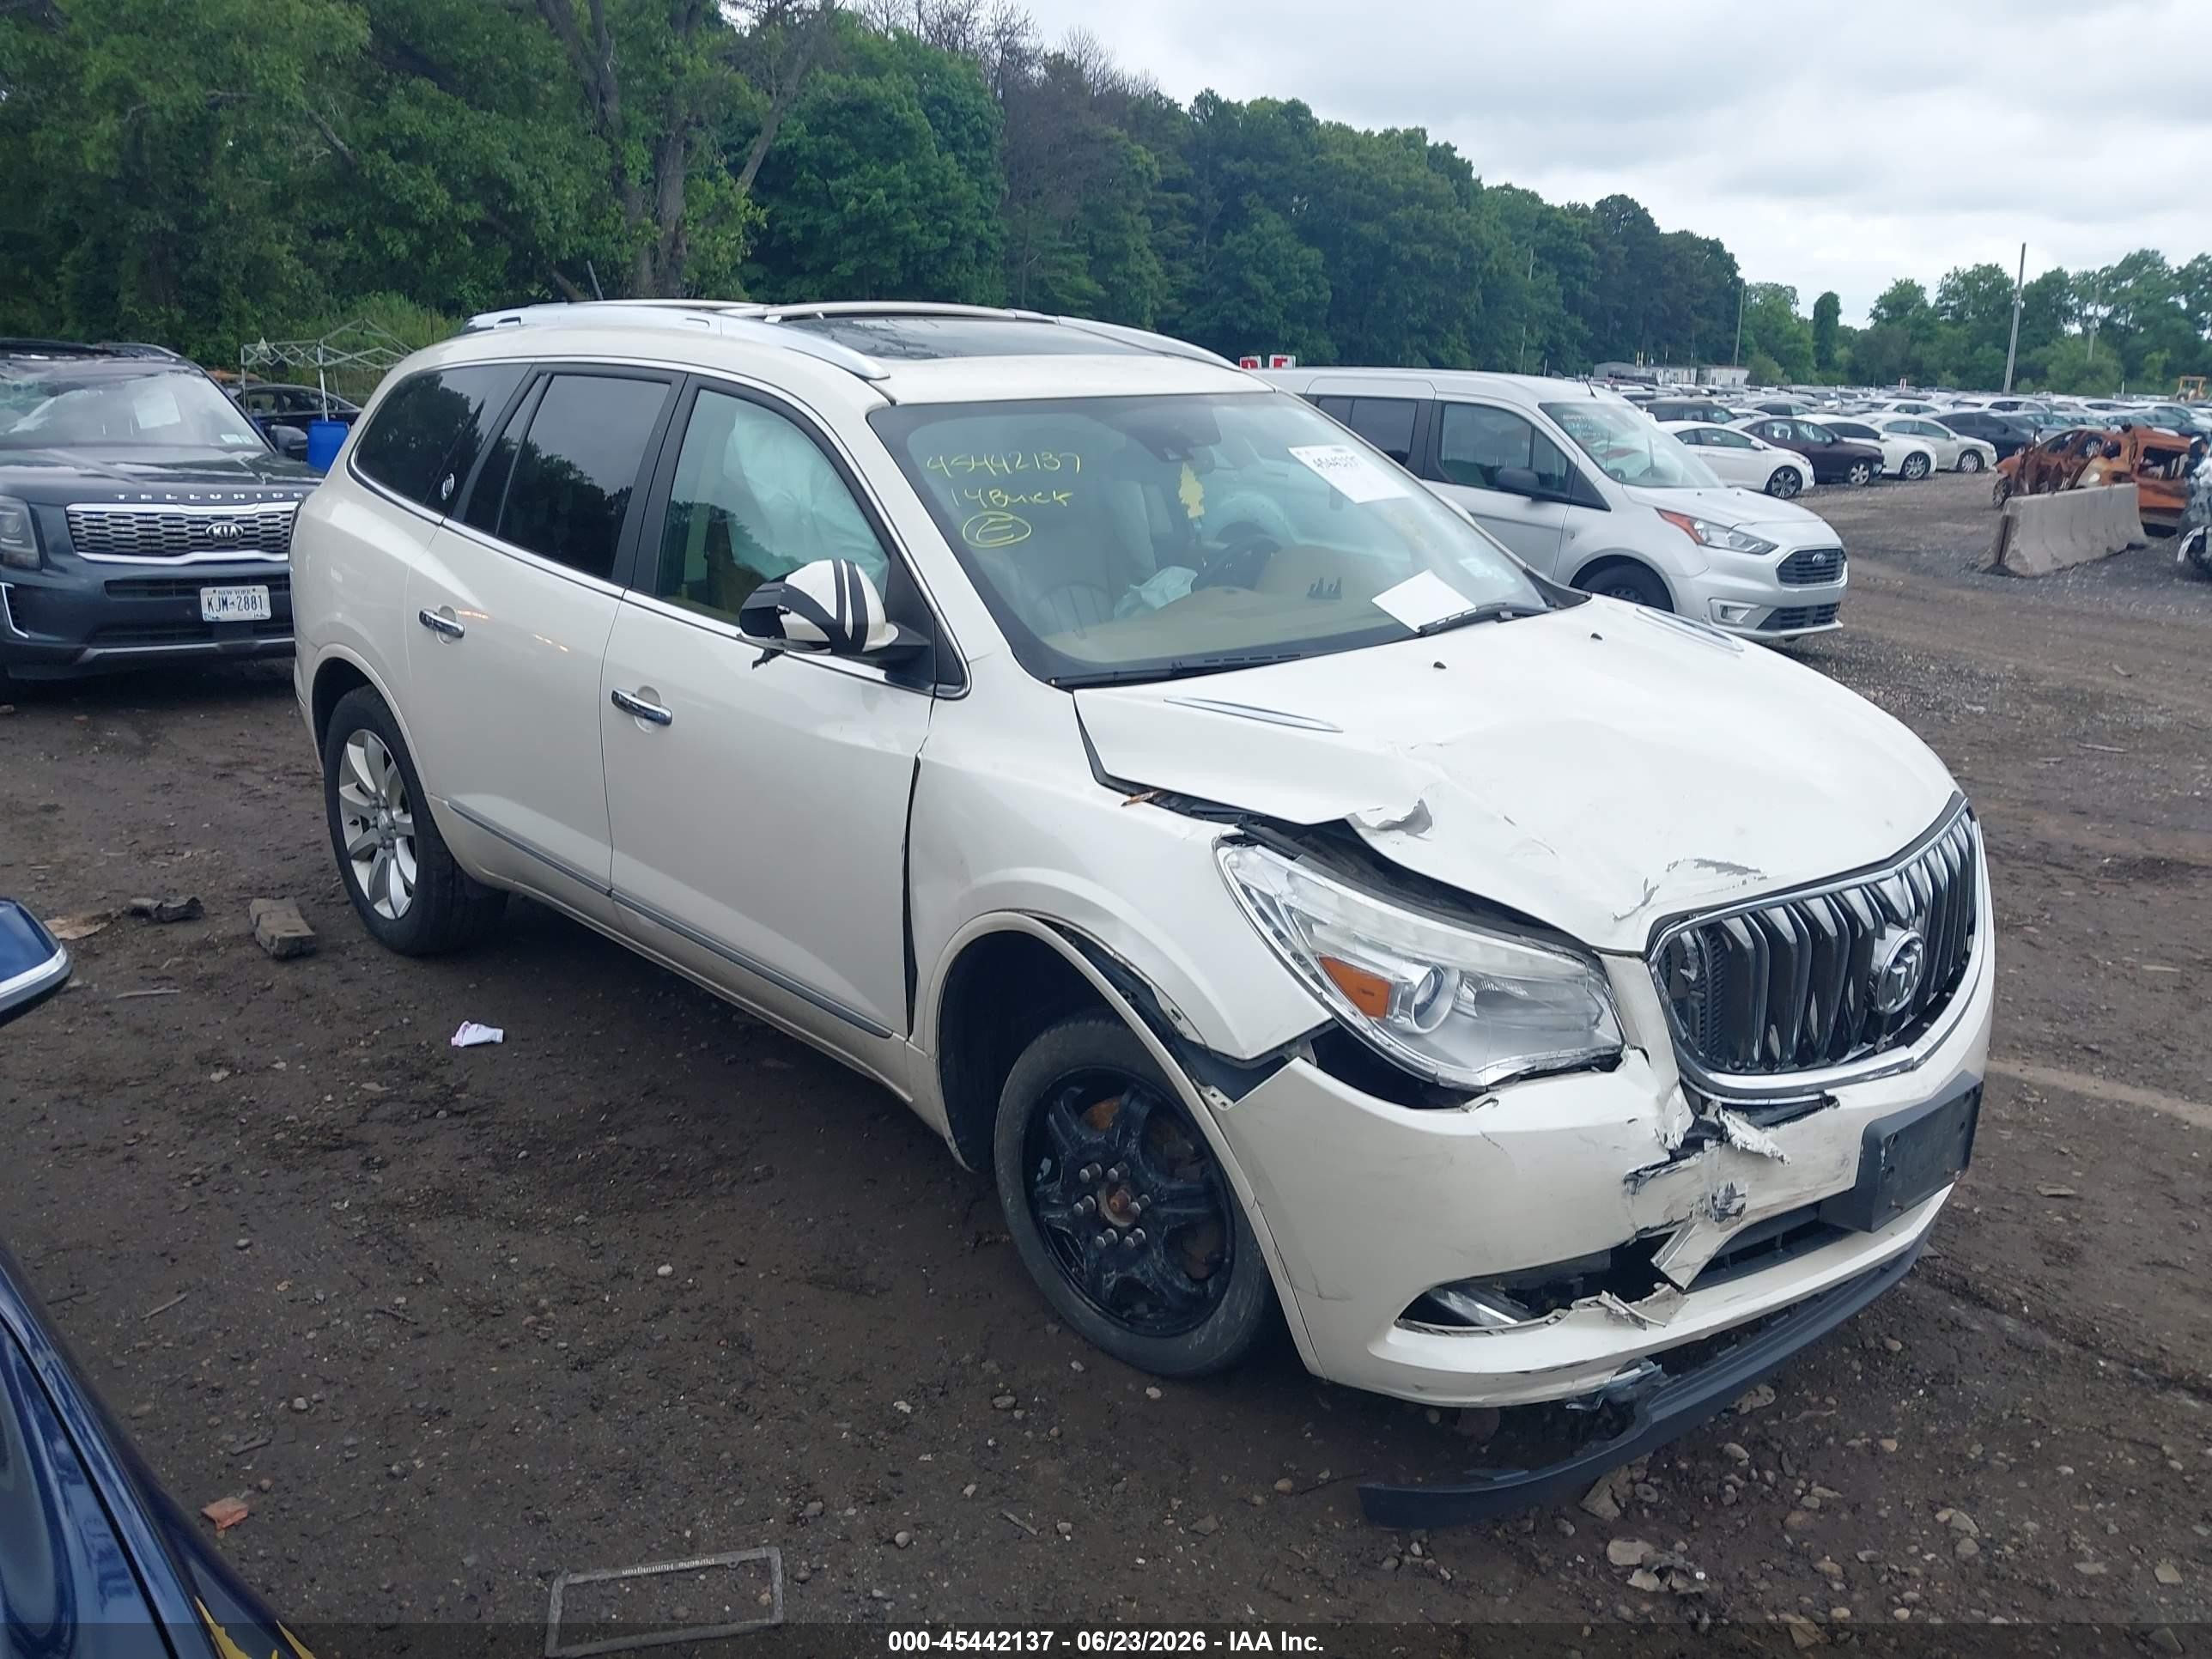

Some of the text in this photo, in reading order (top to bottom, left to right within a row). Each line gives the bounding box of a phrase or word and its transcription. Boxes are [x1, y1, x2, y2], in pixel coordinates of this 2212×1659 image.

[927, 452, 1081, 478] 45442137
[114, 492, 303, 501] TELLURIDE
[212, 526, 239, 538] KIA
